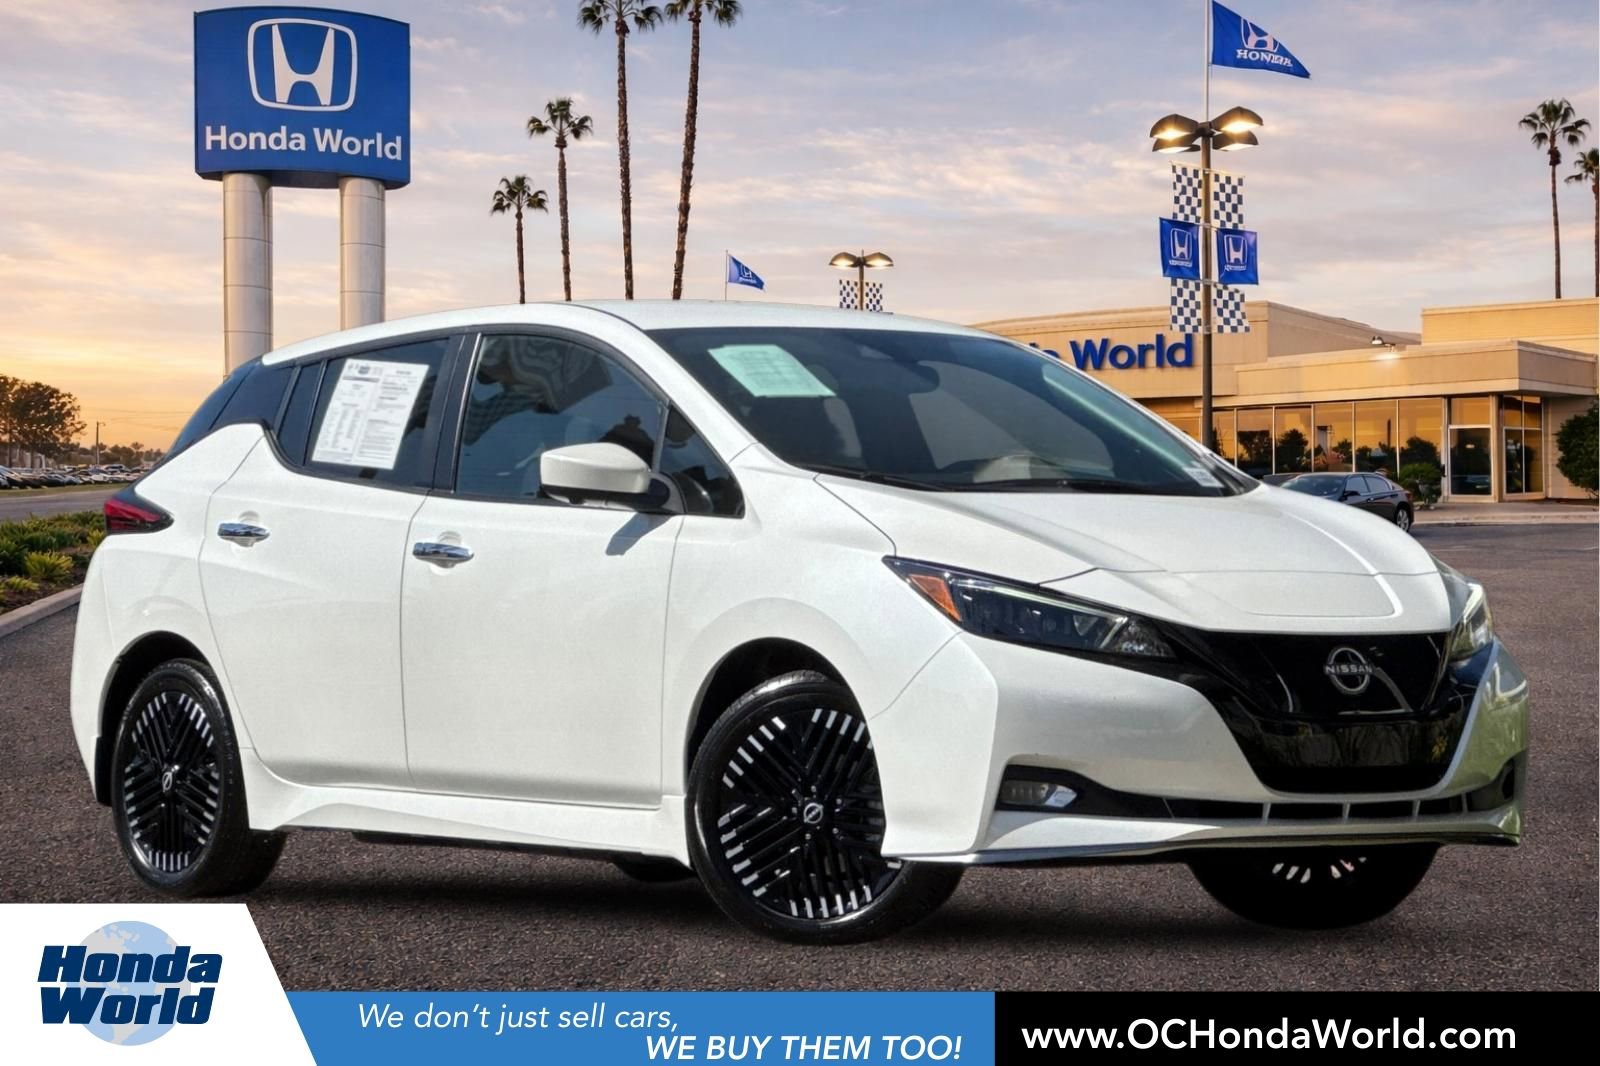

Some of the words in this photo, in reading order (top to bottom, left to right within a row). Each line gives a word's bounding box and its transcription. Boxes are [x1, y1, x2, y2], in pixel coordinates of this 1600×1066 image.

[1236, 49, 1293, 67] HONDA
[205, 125, 306, 151] Honda
[312, 127, 402, 160] World
[1069, 333, 1194, 371] World
[1325, 664, 1373, 675] NISSAN
